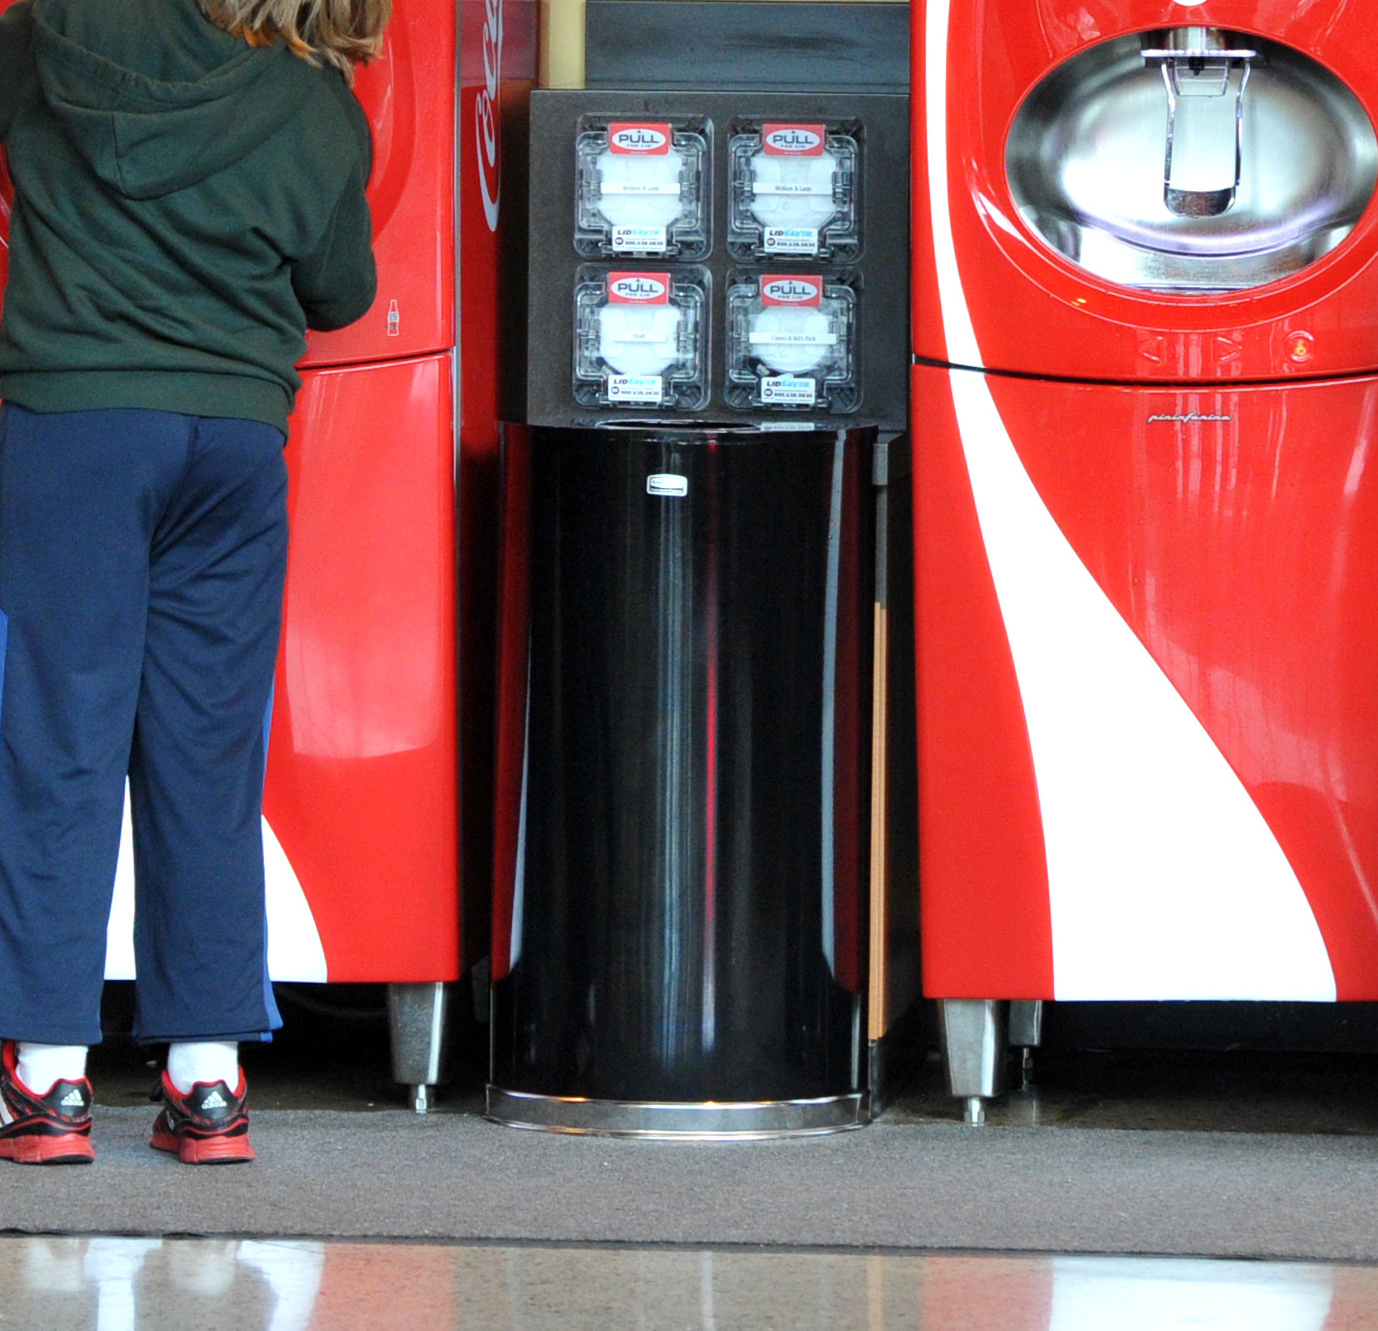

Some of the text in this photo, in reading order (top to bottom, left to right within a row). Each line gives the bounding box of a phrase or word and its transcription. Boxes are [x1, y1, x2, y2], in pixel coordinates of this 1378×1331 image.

[618, 134, 660, 143] PULL
[772, 135, 814, 144] PULL
[617, 283, 659, 293] PULL
[770, 285, 811, 295] PULL
